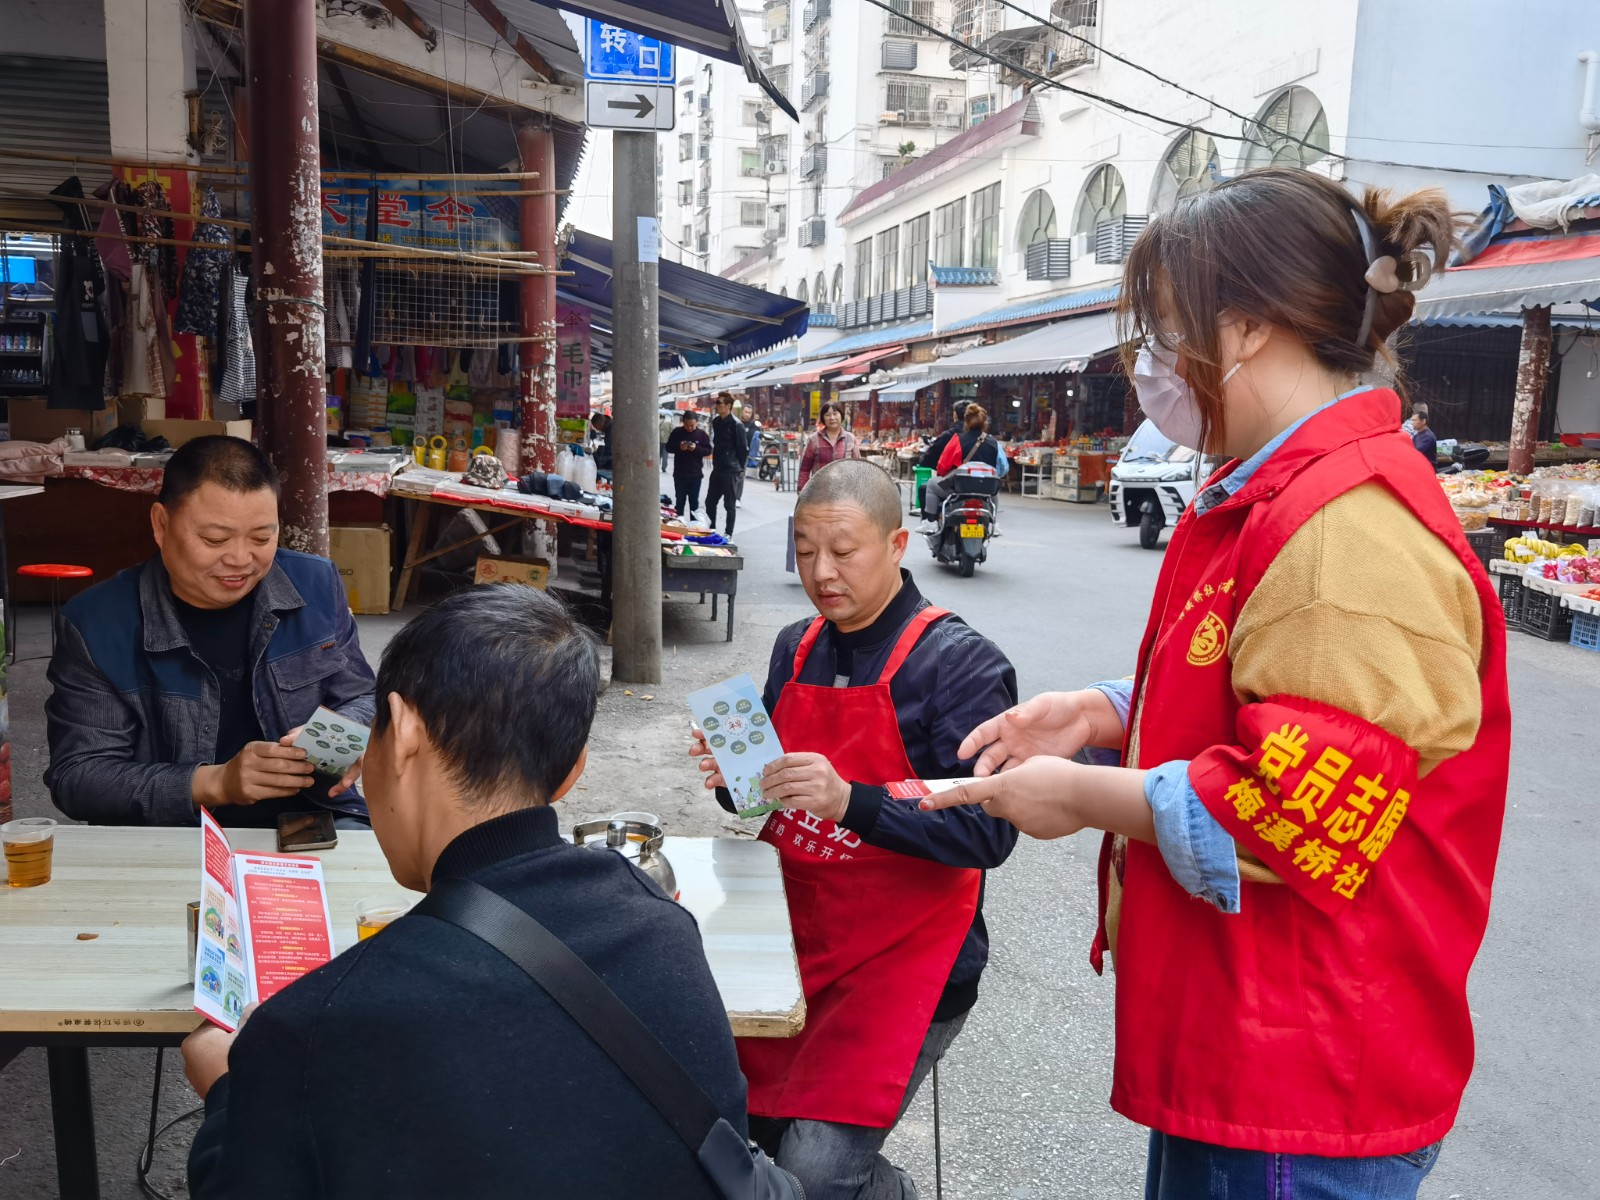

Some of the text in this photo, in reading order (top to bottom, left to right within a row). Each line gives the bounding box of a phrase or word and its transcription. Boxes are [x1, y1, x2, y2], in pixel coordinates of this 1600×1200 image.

[600, 23, 627, 54] 转
[1223, 776, 1369, 900] 梅溪桥社
